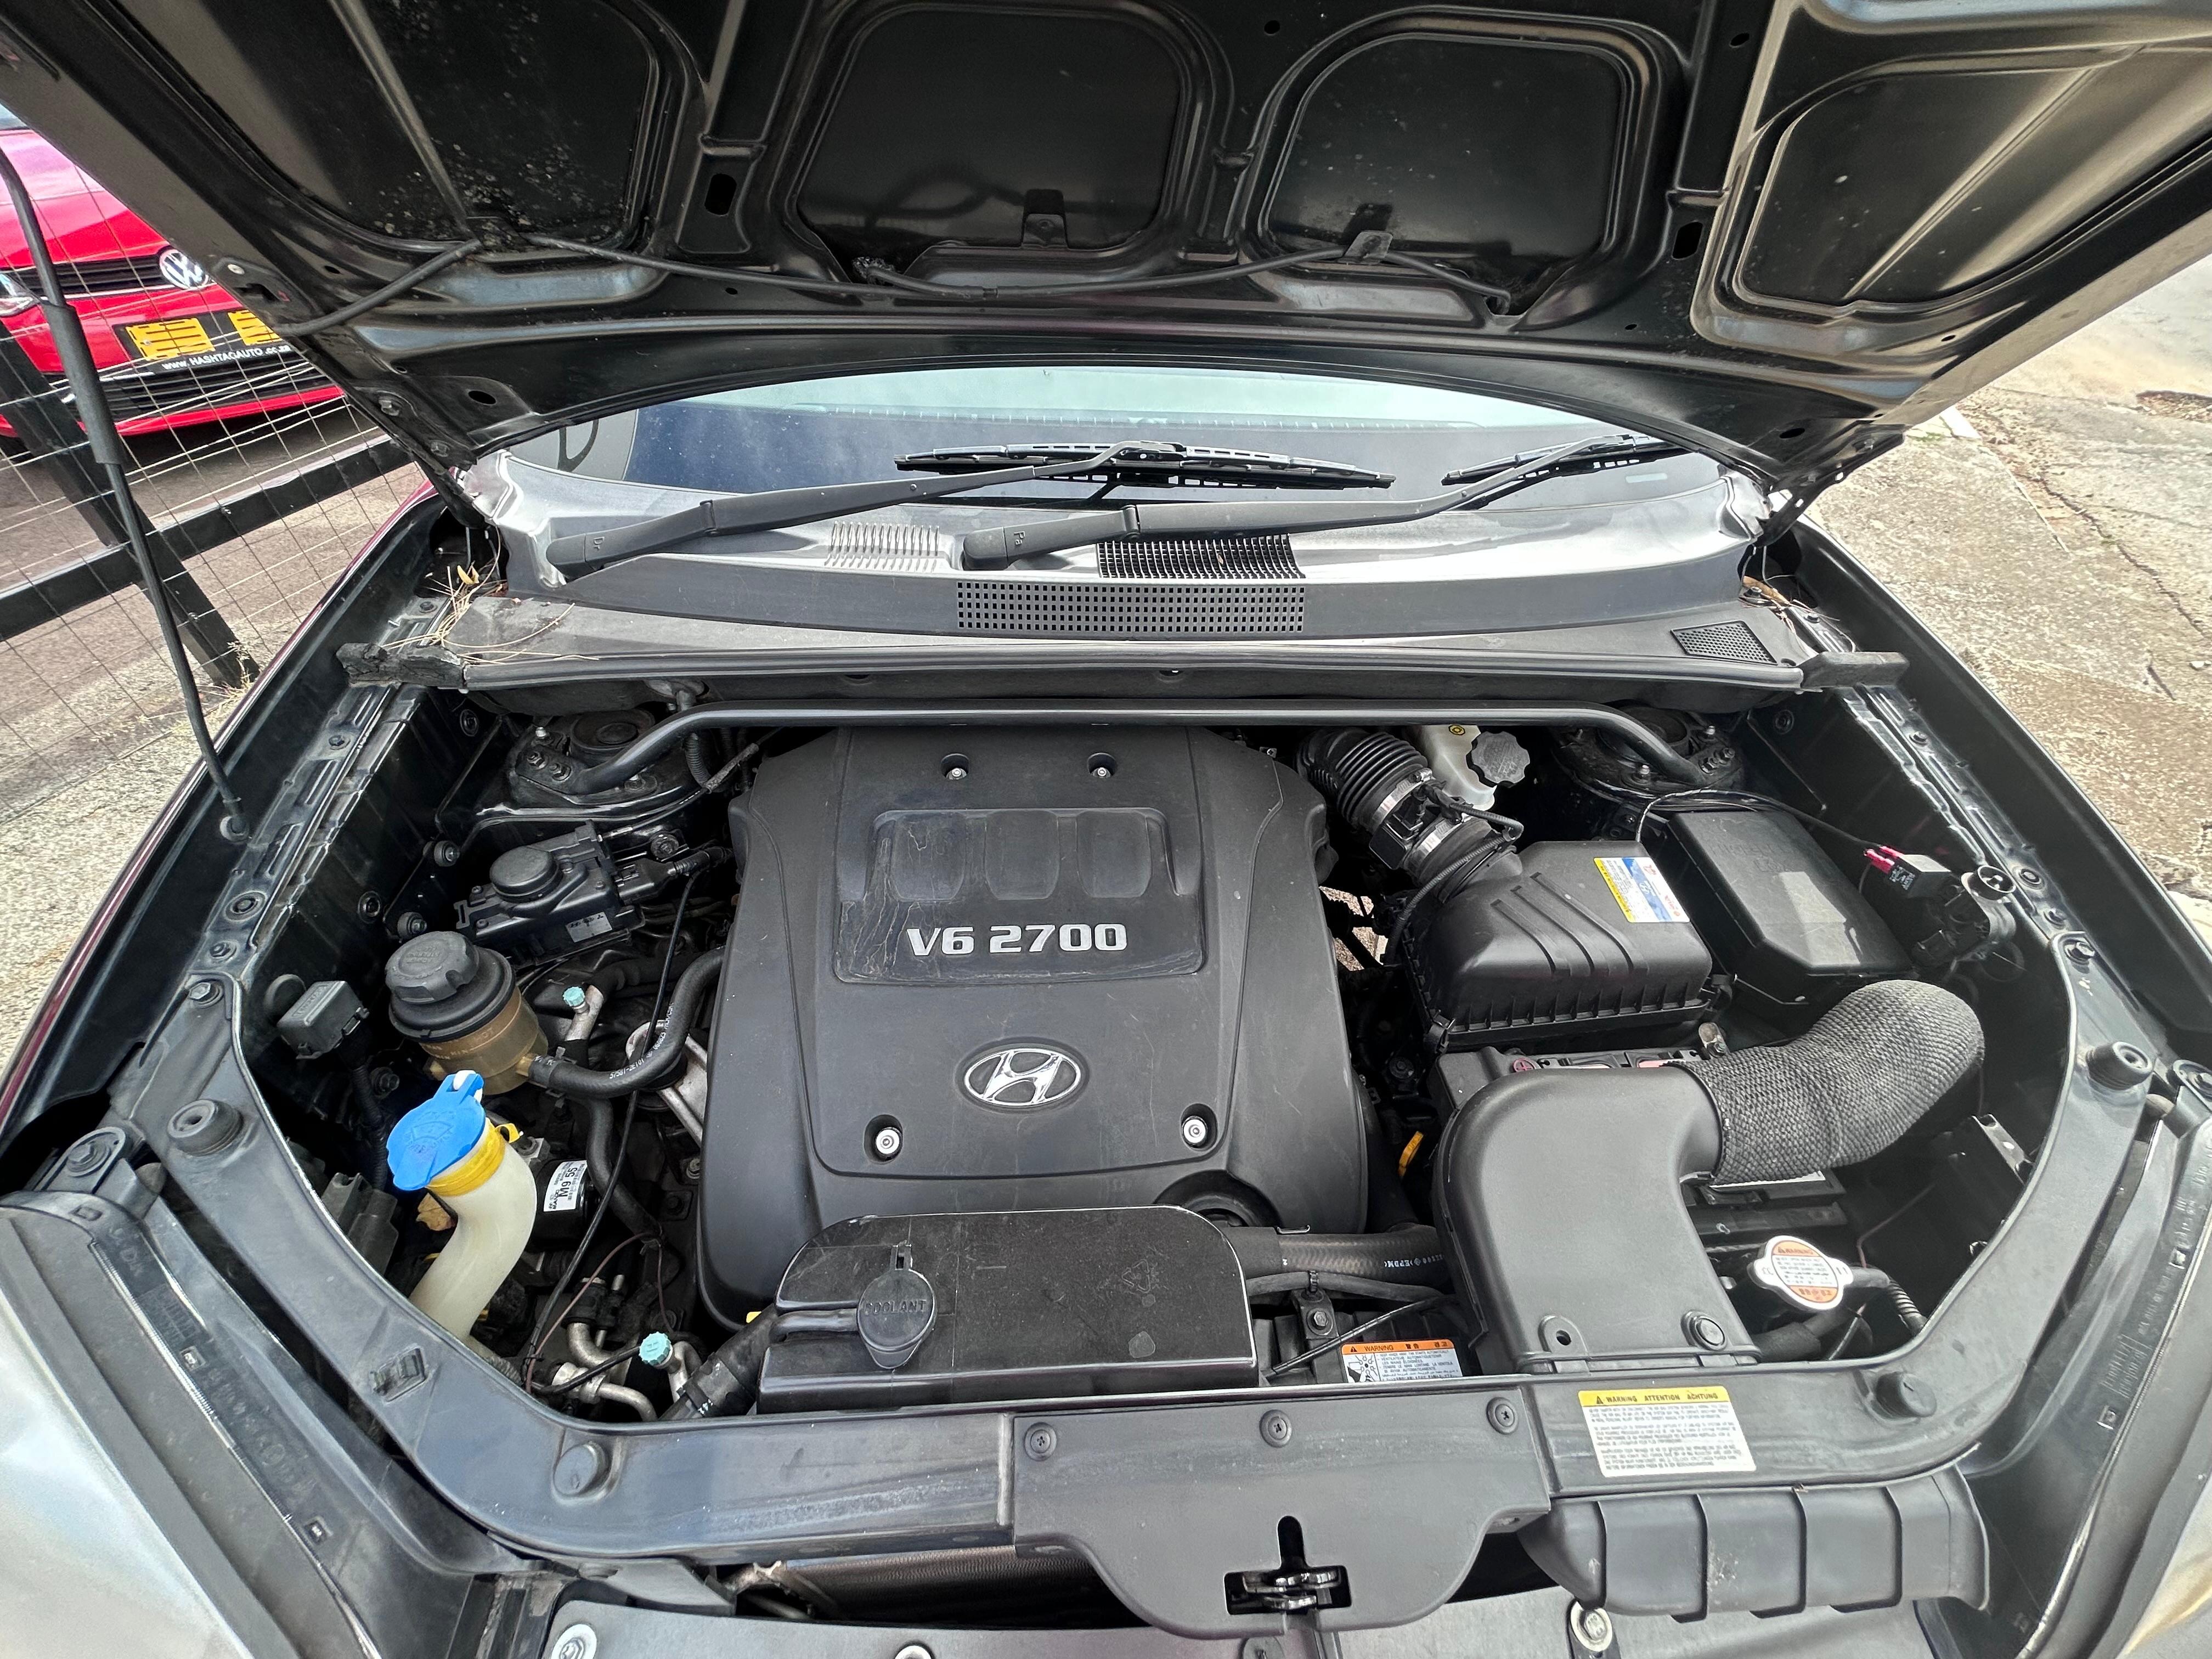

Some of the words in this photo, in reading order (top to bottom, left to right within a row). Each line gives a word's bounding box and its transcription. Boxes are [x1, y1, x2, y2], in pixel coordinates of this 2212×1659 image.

[593, 537, 605, 550] Dr
[1013, 531, 1025, 545] Pa
[906, 927, 974, 956] V6
[990, 924, 1127, 953] 2700
[558, 1181, 572, 1198] M9
[565, 1167, 578, 1177] 55
[864, 1299, 927, 1316] COOLANT
